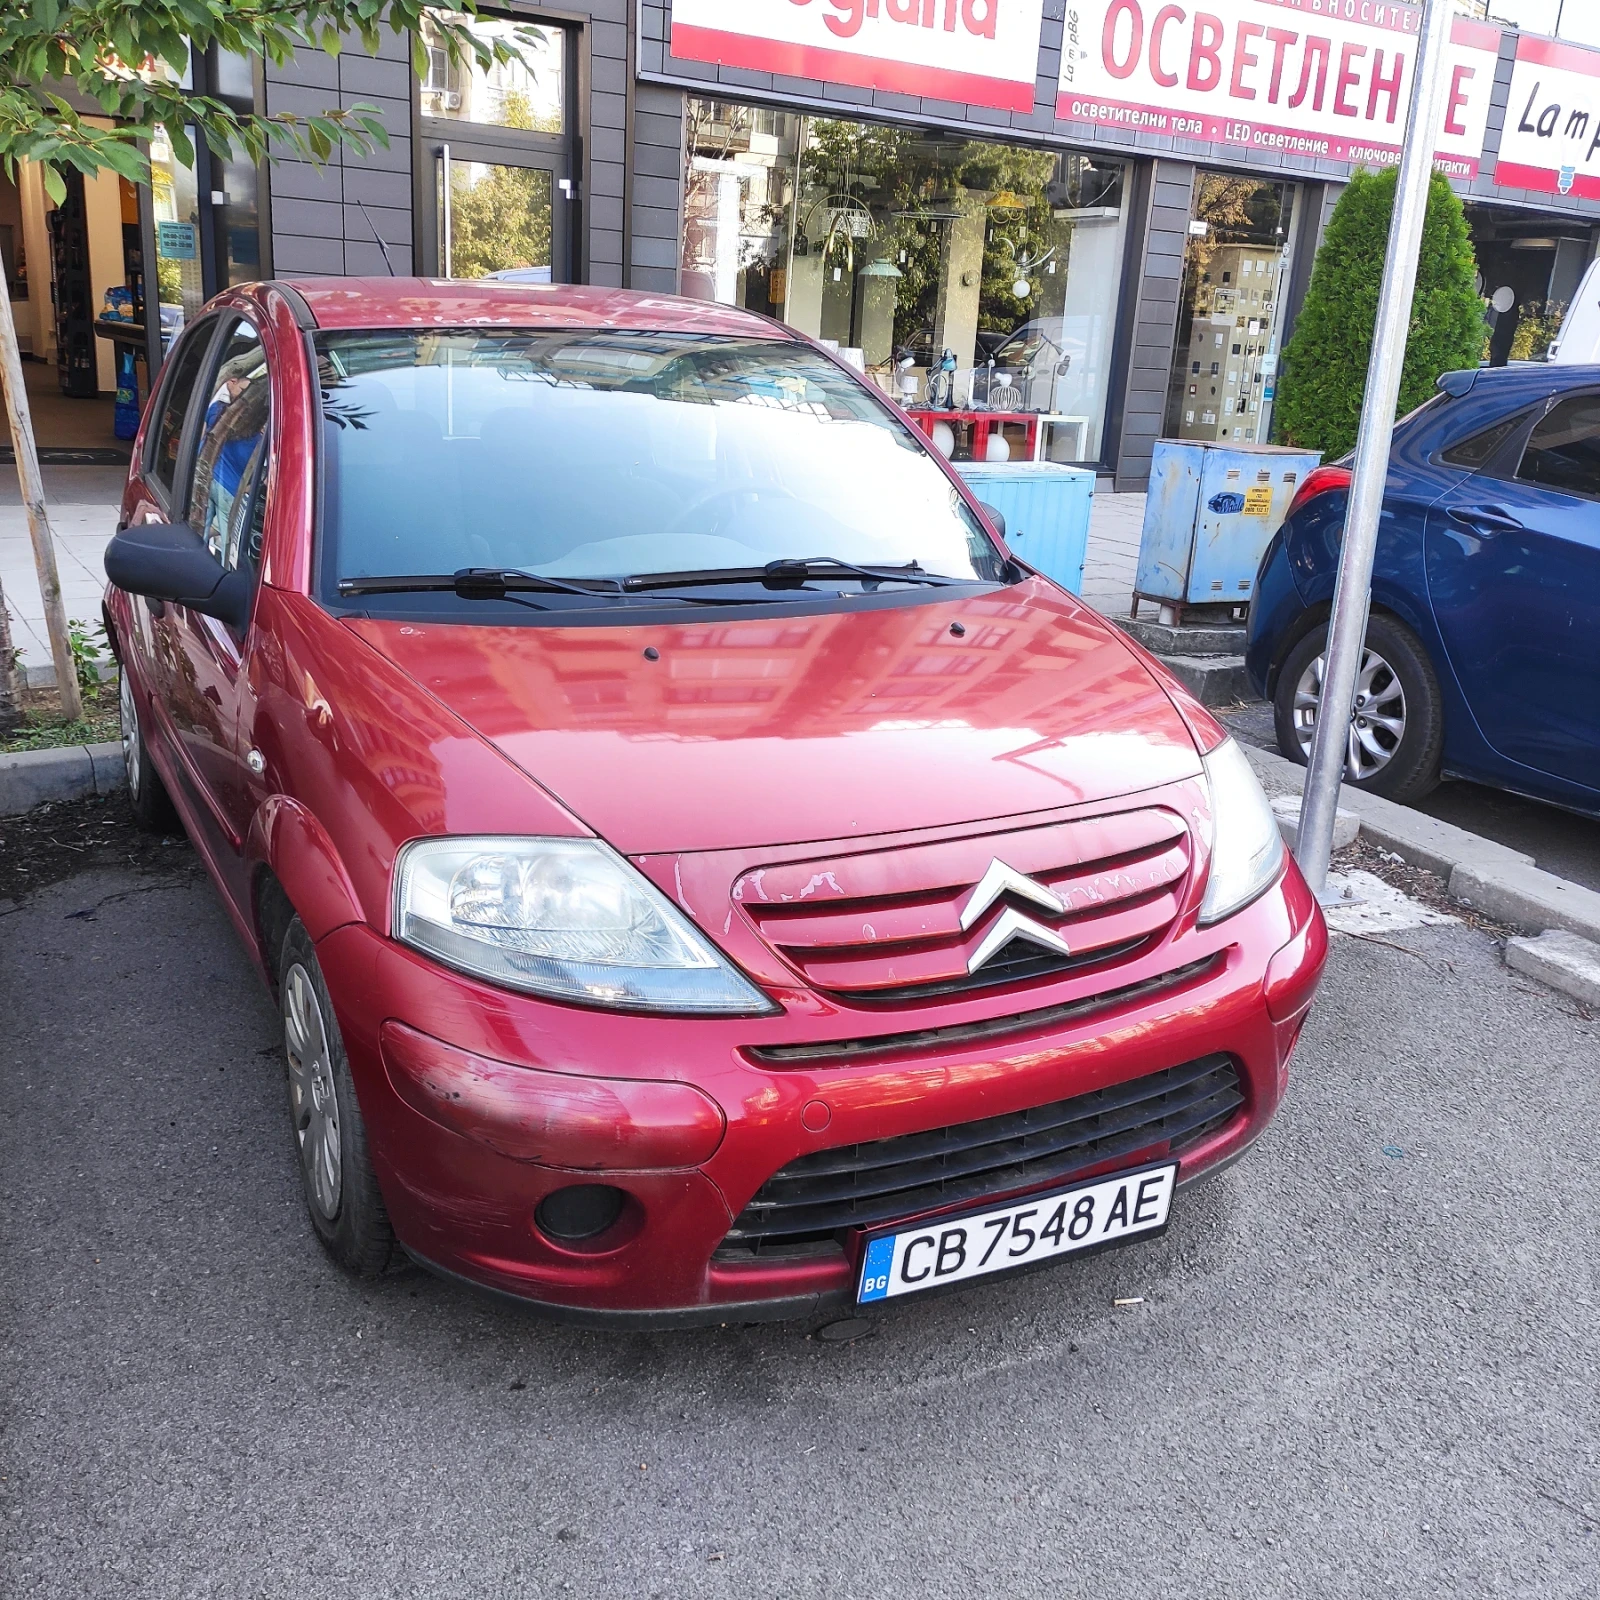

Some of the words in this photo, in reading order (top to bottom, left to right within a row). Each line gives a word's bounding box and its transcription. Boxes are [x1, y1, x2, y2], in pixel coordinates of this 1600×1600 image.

[1101, 0, 1476, 135] ОСВЕТЛЕНЕ
[1071, 100, 1167, 128] осветителни
[1171, 115, 1203, 134] тела
[1225, 122, 1250, 142] LED
[1253, 130, 1329, 154] осветление
[1348, 146, 1402, 164] ключове
[1432, 159, 1471, 175] нтакти
[901, 1227, 967, 1283] CB
[978, 1195, 1095, 1267] 7548
[1103, 1175, 1165, 1233] AE
[864, 1276, 887, 1293] BG
